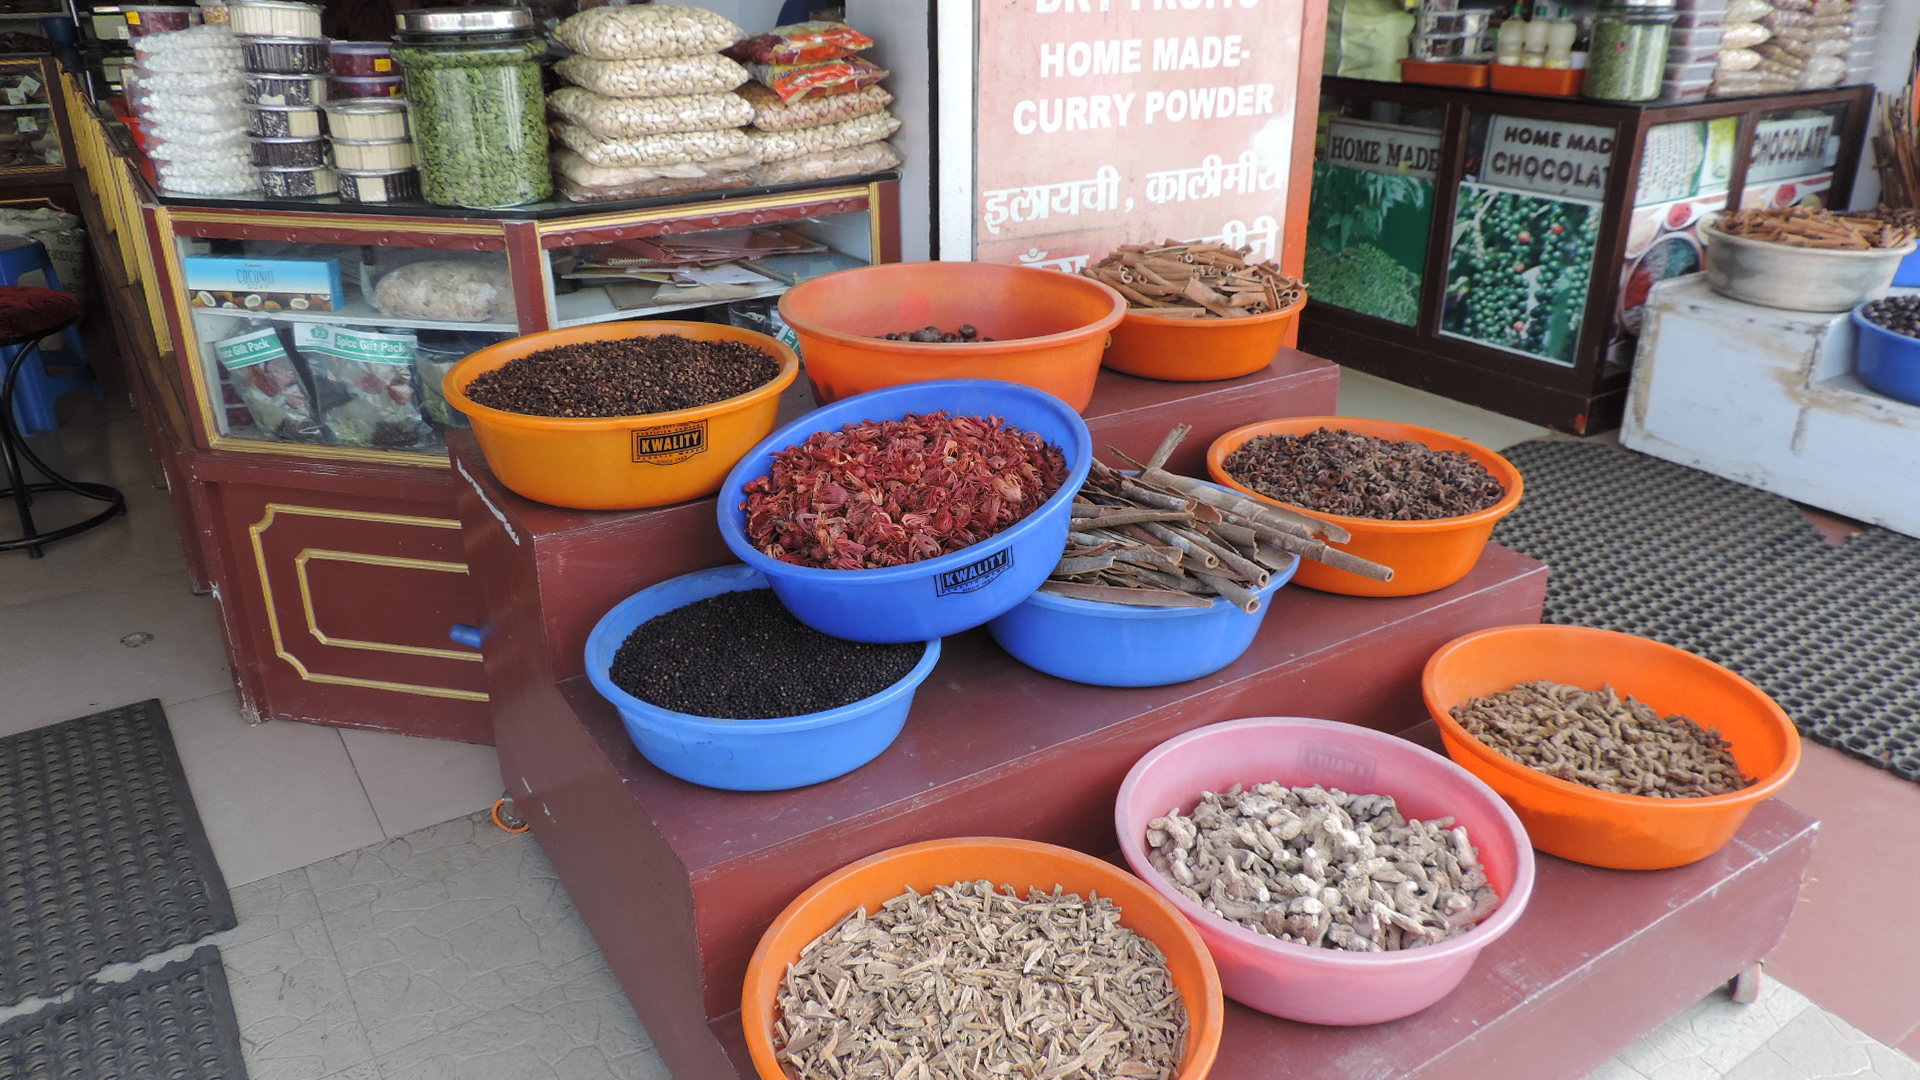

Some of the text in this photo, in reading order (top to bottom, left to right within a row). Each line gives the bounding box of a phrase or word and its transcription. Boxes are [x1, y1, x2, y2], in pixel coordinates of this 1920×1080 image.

[1040, 35, 1250, 77] HOME MADE-
[1013, 83, 1274, 135] CURRY POWDER
[1504, 126, 1562, 148] HOME
[1330, 137, 1441, 172] HOME MADE
[236, 269, 275, 284] COCONUT
[232, 344, 248, 356] Gift
[247, 338, 270, 352] Pack
[336, 336, 357, 349] Spice
[359, 339, 377, 350] Gift
[380, 342, 406, 353] Pack
[641, 431, 699, 453] KWALITY
[944, 551, 1004, 586] KWALITY
